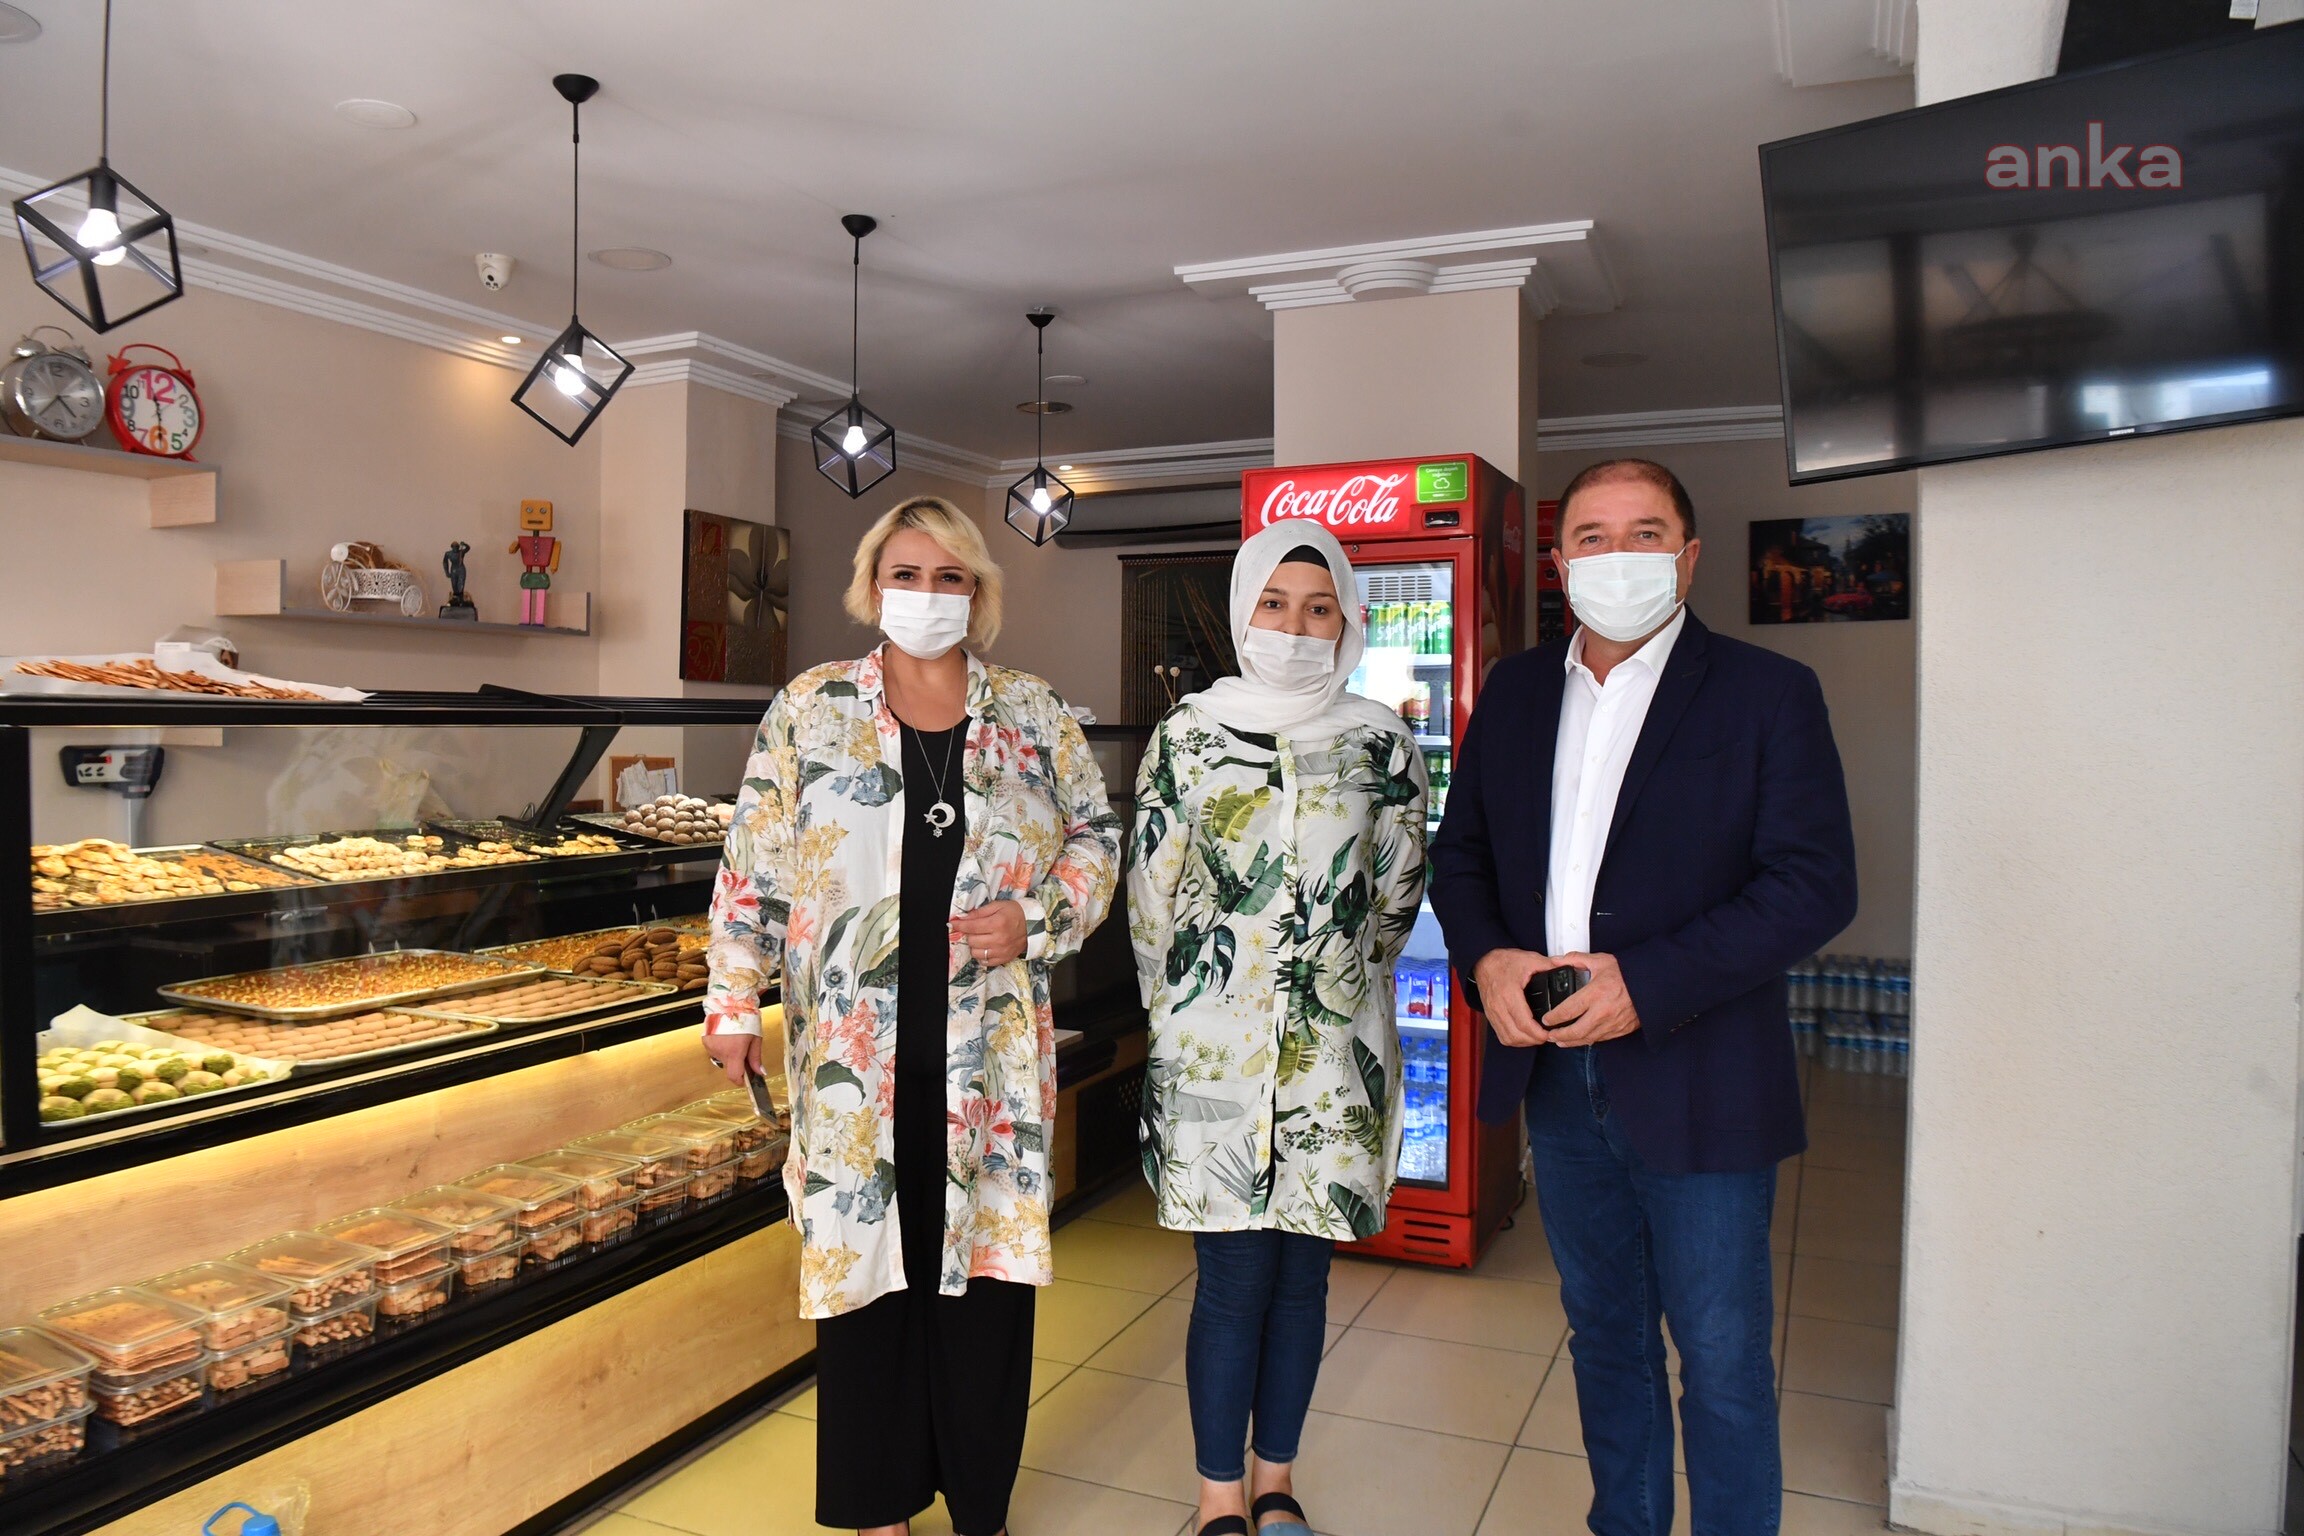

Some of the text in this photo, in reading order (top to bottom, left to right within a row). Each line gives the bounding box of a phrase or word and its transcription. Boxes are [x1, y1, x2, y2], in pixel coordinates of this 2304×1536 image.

[123, 384, 140, 399] 10
[140, 370, 175, 404] 12
[80, 397, 90, 408] 3
[121, 394, 136, 420] 9
[179, 394, 189, 408] 2
[127, 419, 136, 432] 8
[183, 406, 196, 428] 3
[136, 427, 149, 444] 7
[149, 425, 169, 455] 6
[171, 432, 183, 451] 5
[1260, 473, 1409, 528] Coca-Cola
